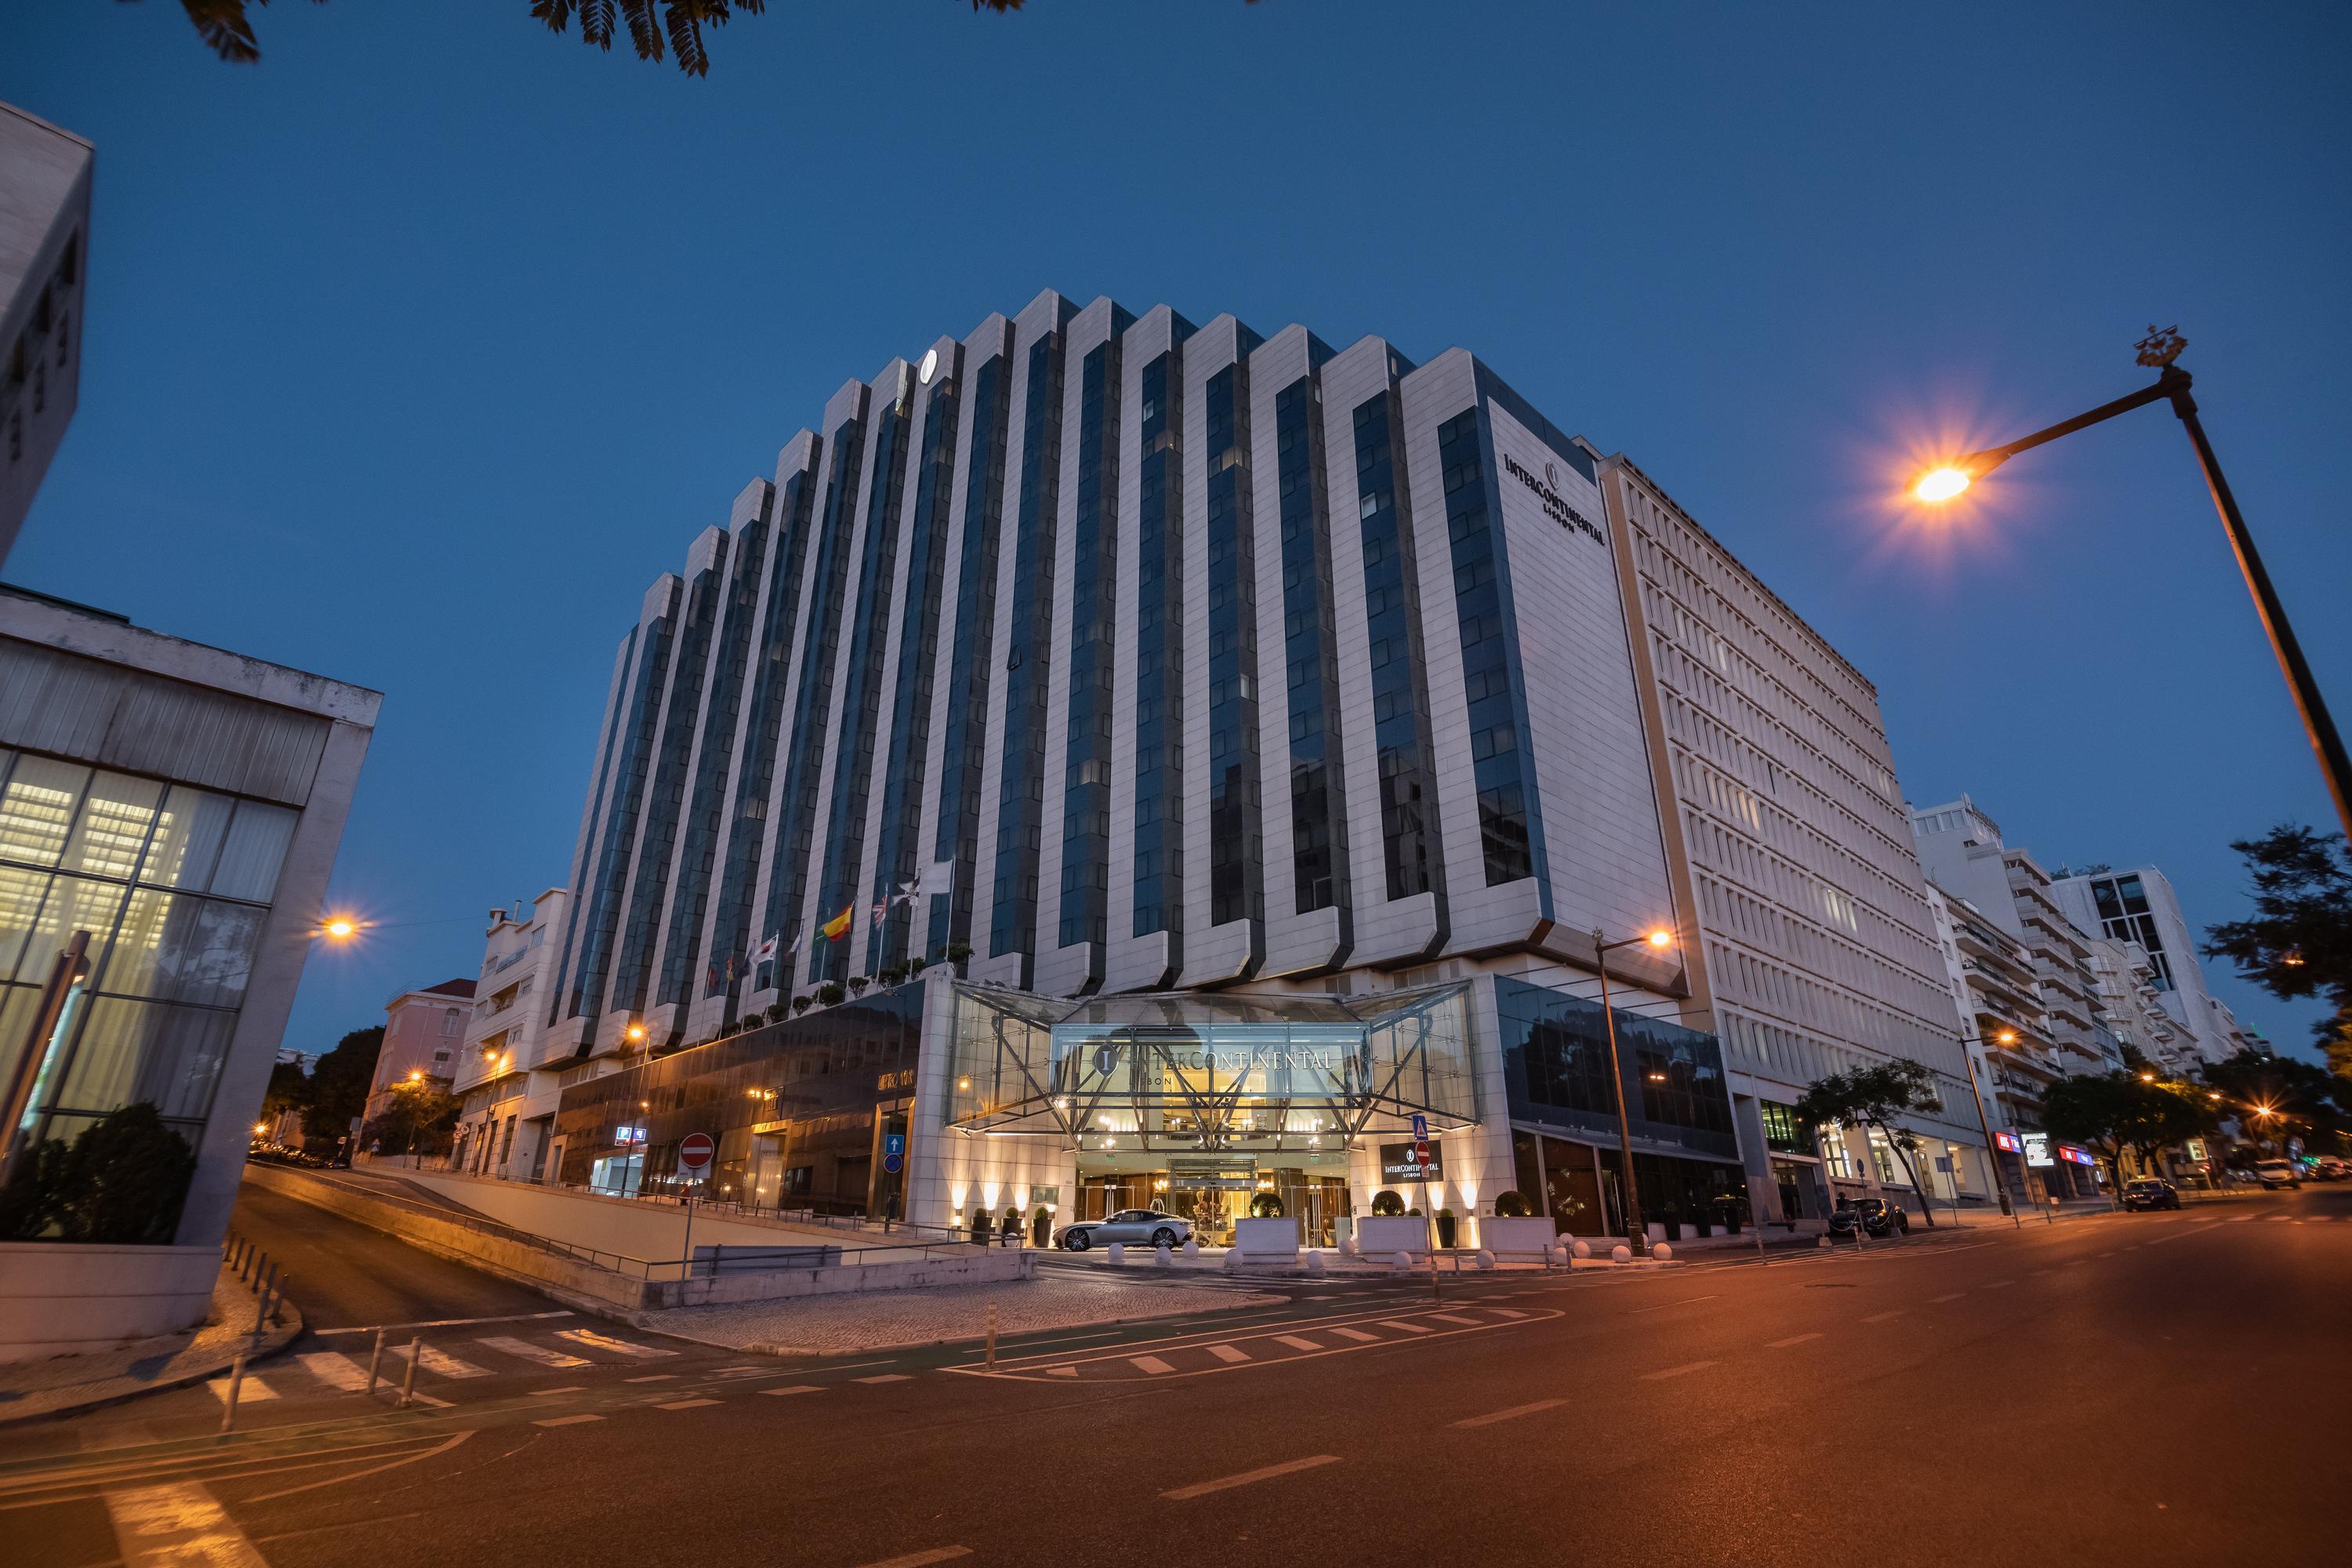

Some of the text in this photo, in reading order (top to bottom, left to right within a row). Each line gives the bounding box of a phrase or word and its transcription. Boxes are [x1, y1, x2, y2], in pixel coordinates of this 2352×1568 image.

[1504, 453, 1605, 546] INTERCONTINENTAL
[1543, 503, 1575, 534] LISBON
[1130, 1050, 1333, 1070] NTERCONTINENTAL
[1385, 1163, 1439, 1173] INTERCONTINTAL
